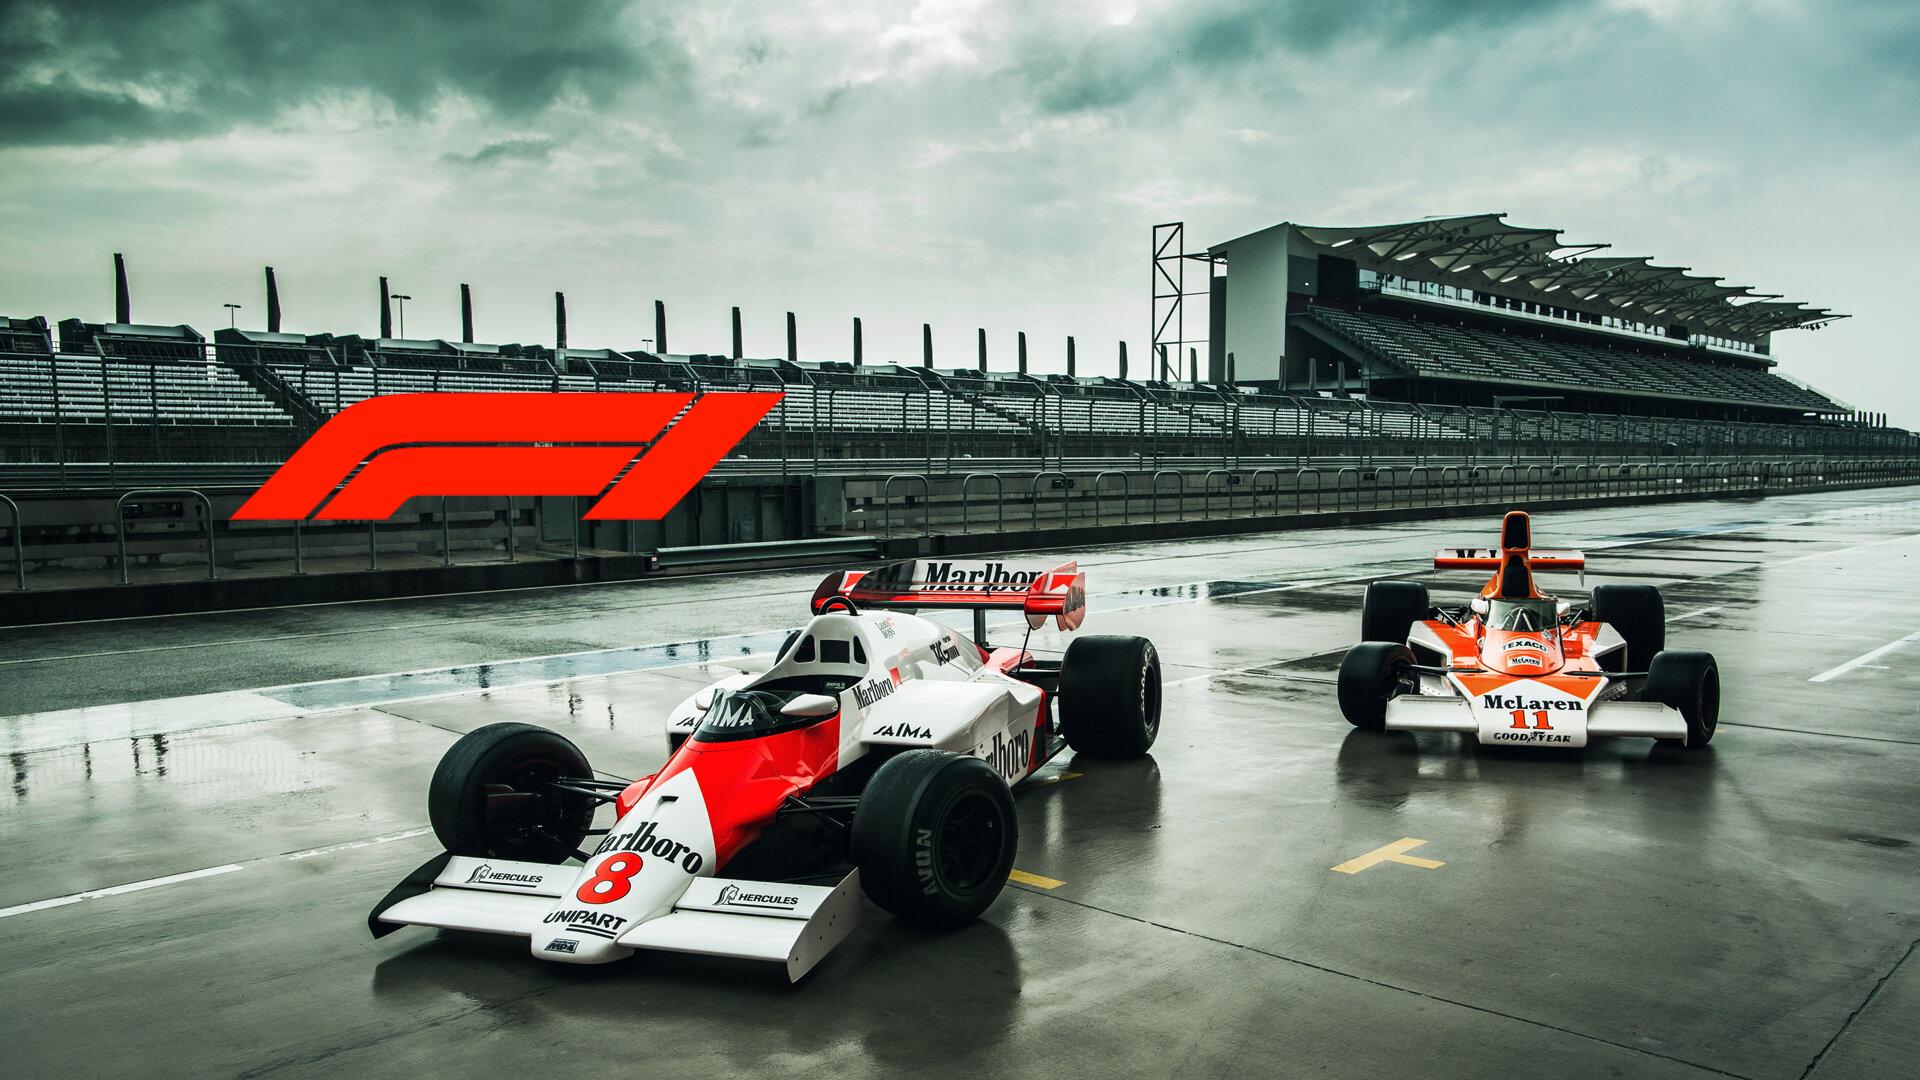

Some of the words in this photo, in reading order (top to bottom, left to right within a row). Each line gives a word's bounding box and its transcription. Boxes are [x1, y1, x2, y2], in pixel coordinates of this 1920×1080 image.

[921, 562, 1044, 591] Marlbor
[1502, 641, 1547, 652] TEXACO
[1511, 658, 1541, 666] McLaren
[851, 678, 895, 711] Marlboro
[1484, 695, 1584, 711] McLaren
[873, 722, 932, 739] SAIMA
[1509, 709, 1554, 731] 11
[984, 729, 1029, 780] lboro
[594, 822, 703, 875] arlboro
[488, 872, 543, 883] HERCULES
[576, 851, 644, 905] 8
[738, 893, 799, 905] HERCULES
[543, 910, 628, 931] UNIPART
